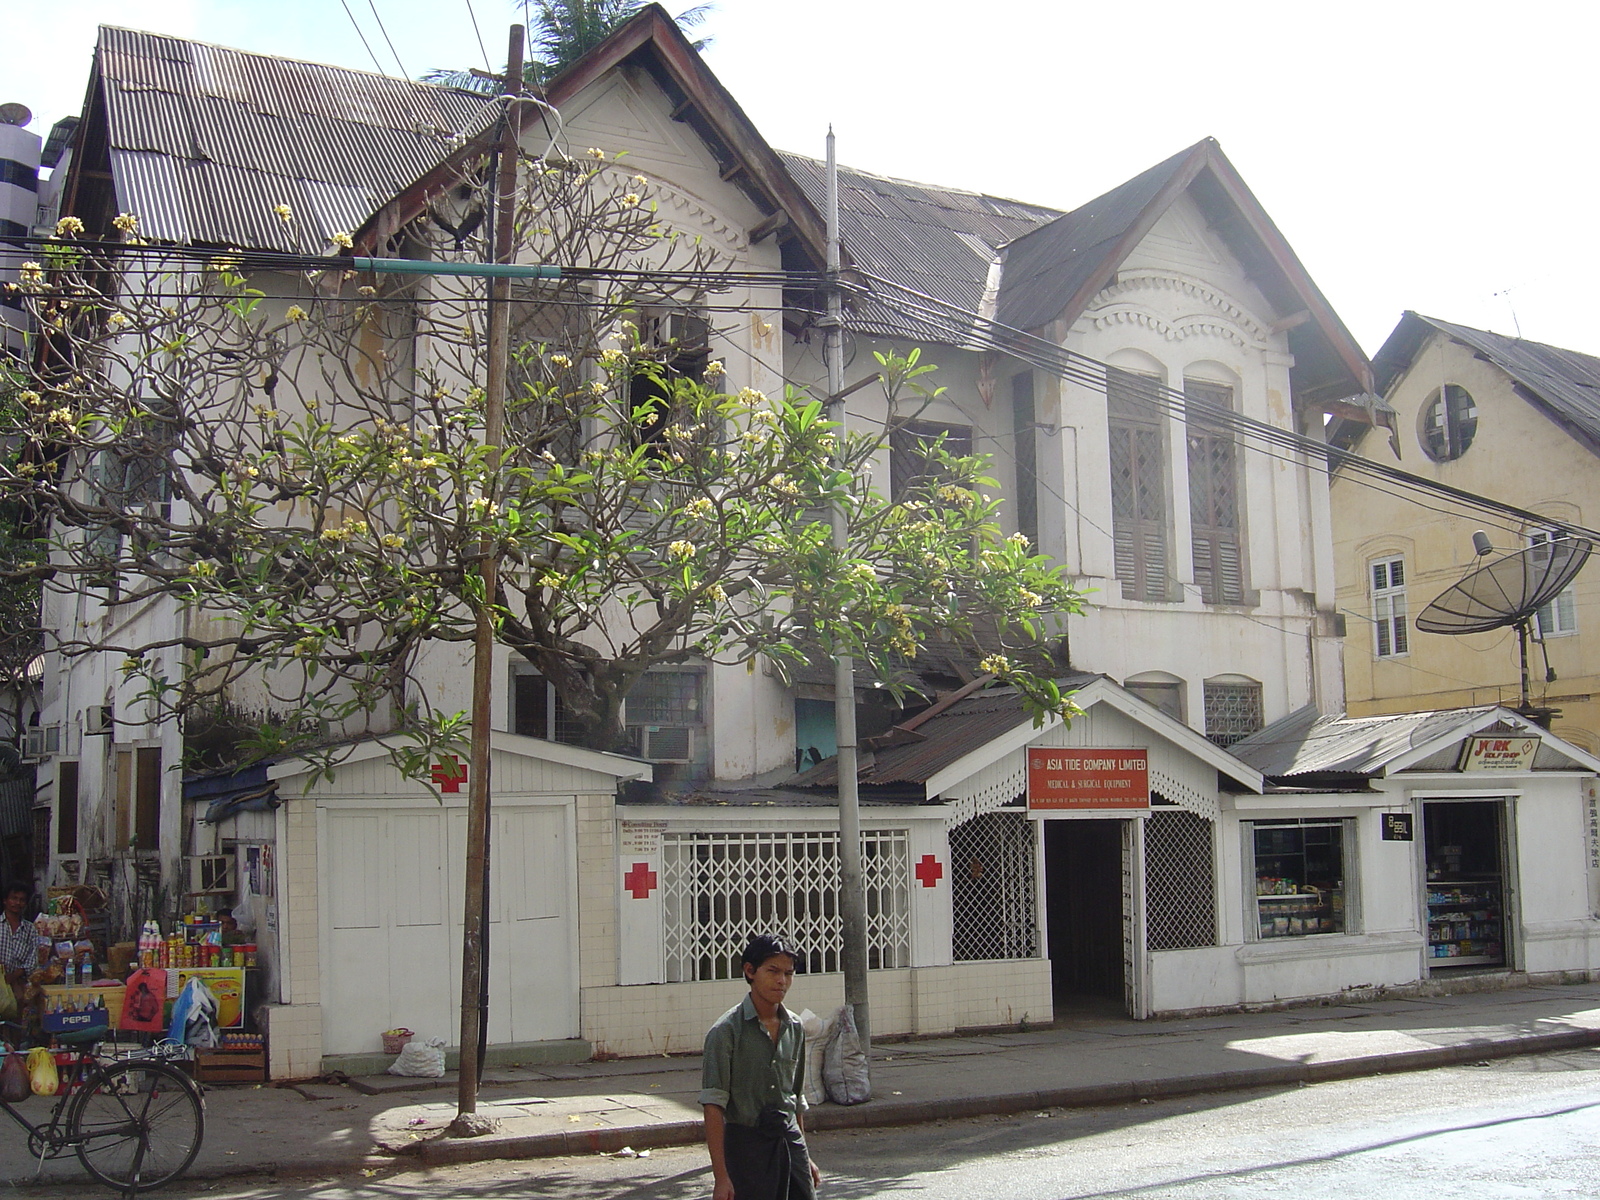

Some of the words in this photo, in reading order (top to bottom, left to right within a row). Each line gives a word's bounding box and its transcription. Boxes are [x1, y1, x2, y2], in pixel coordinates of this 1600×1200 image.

[1046, 758, 1063, 771] ASIA
[1065, 759, 1081, 771] TIDE
[1083, 759, 1116, 771] COMPANY
[1118, 759, 1146, 771] LIMITED
[1047, 780, 1069, 789] MEDICAL
[1071, 780, 1076, 789] &
[1077, 780, 1101, 789] SURGICAL
[1103, 779, 1131, 789] EQUIPMENT
[62, 1015, 91, 1025] PEPSI
